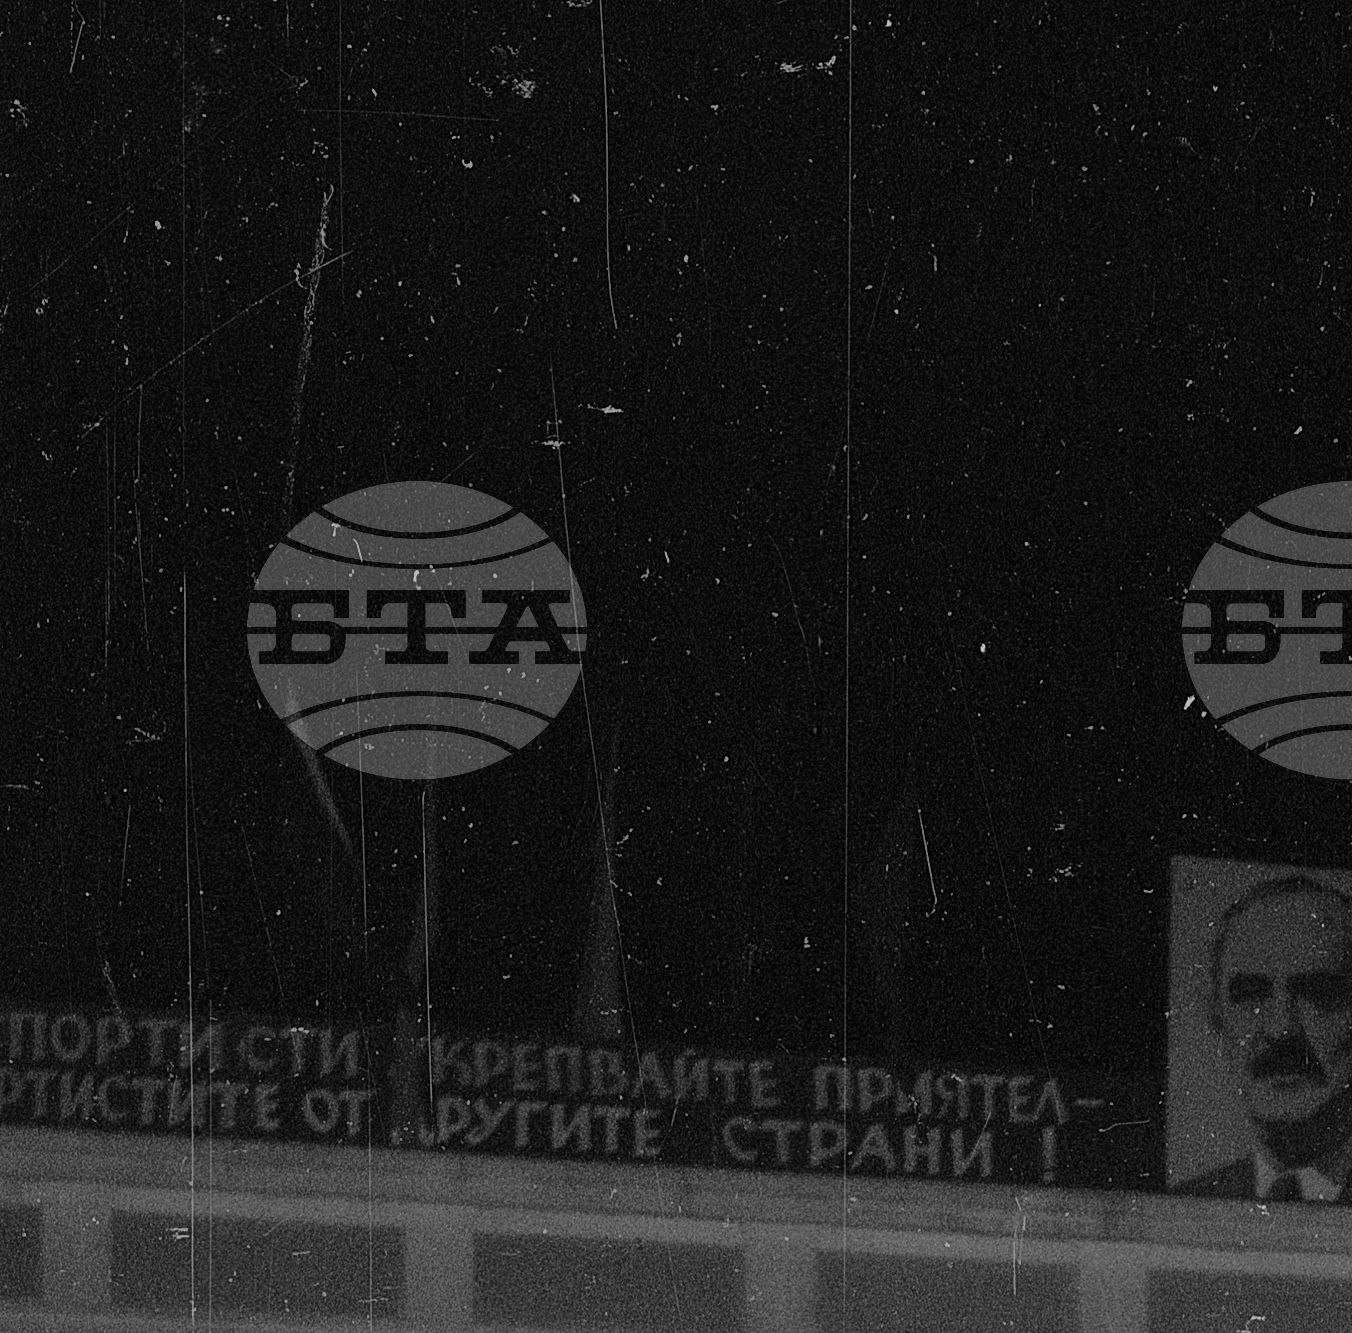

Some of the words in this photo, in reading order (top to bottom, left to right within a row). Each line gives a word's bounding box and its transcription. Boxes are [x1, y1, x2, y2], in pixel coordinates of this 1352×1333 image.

[0, 1011, 361, 1079] ПОРТИСТИ
[394, 1032, 778, 1109] КРЕПВАЙТЕ
[304, 1088, 371, 1138] ОТ
[390, 1095, 662, 1158] РУГИТЕ
